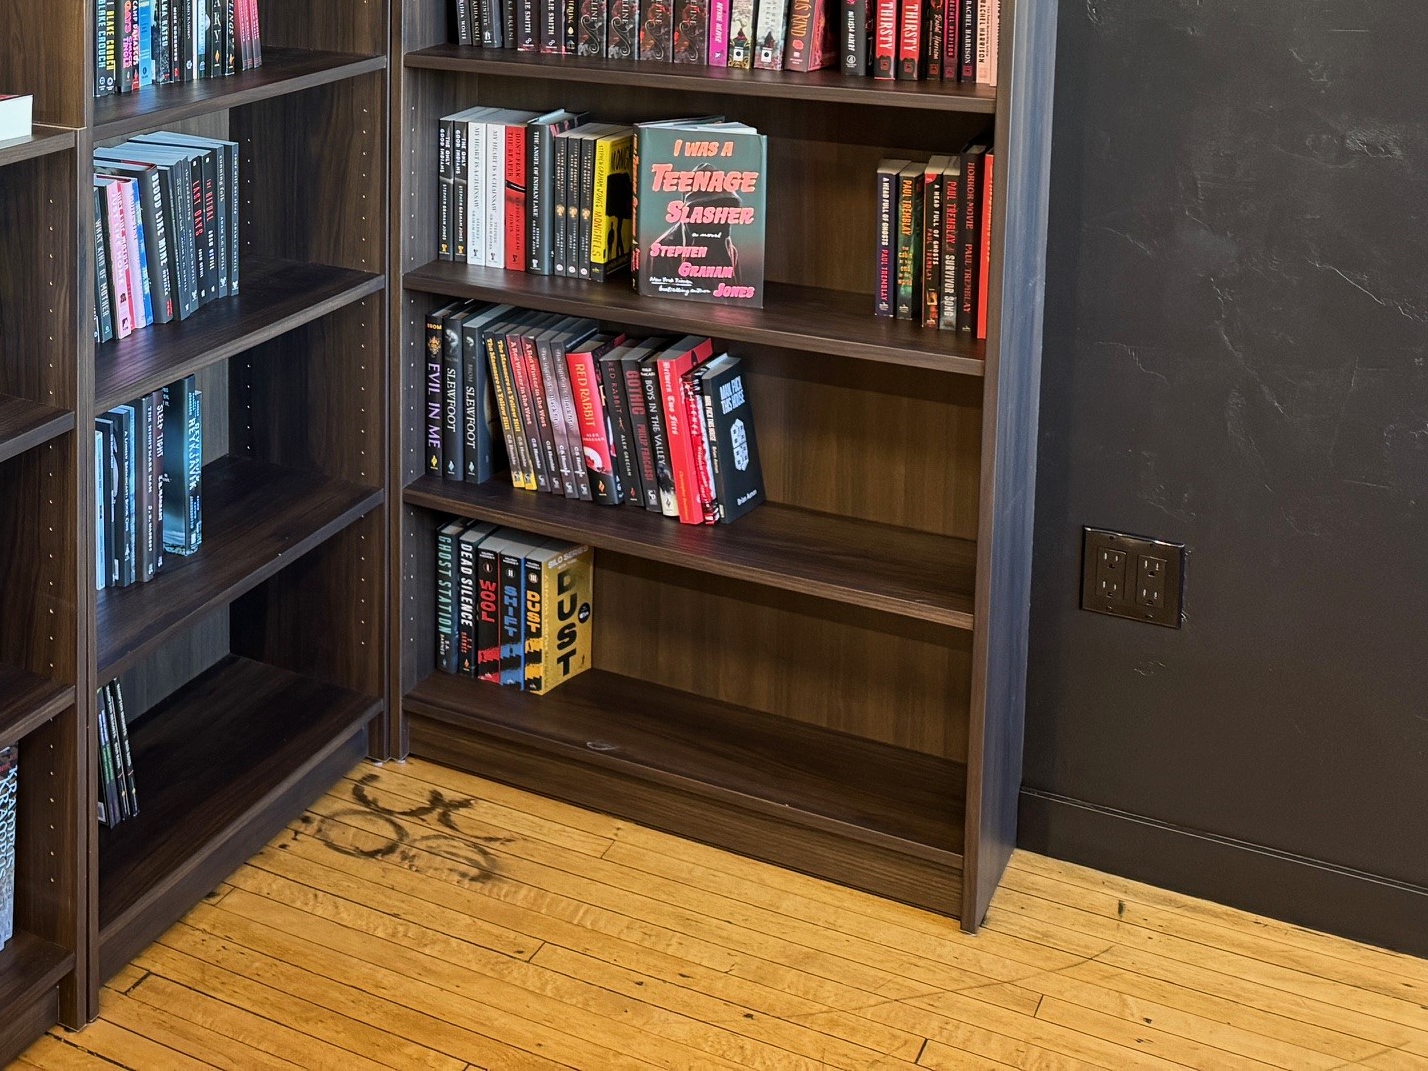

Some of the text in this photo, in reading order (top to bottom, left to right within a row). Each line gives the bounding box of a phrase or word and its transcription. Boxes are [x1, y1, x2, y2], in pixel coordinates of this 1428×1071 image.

[879, 2, 894, 50] THIRSTY
[674, 139, 734, 156] I WAS A
[652, 163, 760, 193] TEENAGE
[665, 201, 755, 224] SLASHER
[650, 243, 708, 259] STEPHEN
[678, 262, 734, 278] GRAHAM
[713, 283, 755, 299] JONES
[428, 363, 441, 449] EVIL IN ME
[447, 368, 456, 433] SLEWFOOT
[575, 363, 595, 426] RED RABBIT
[626, 370, 645, 416] GOTHIC
[645, 379, 666, 465] BOYS IN THE VALLEY
[438, 535, 452, 634] GHOST STATION
[461, 543, 472, 627] DEAD SILENCE
[479, 579, 497, 623] WOOL
[504, 585, 518, 637] SHIFT
[526, 590, 541, 633] DUST
[556, 571, 578, 677] DUST
